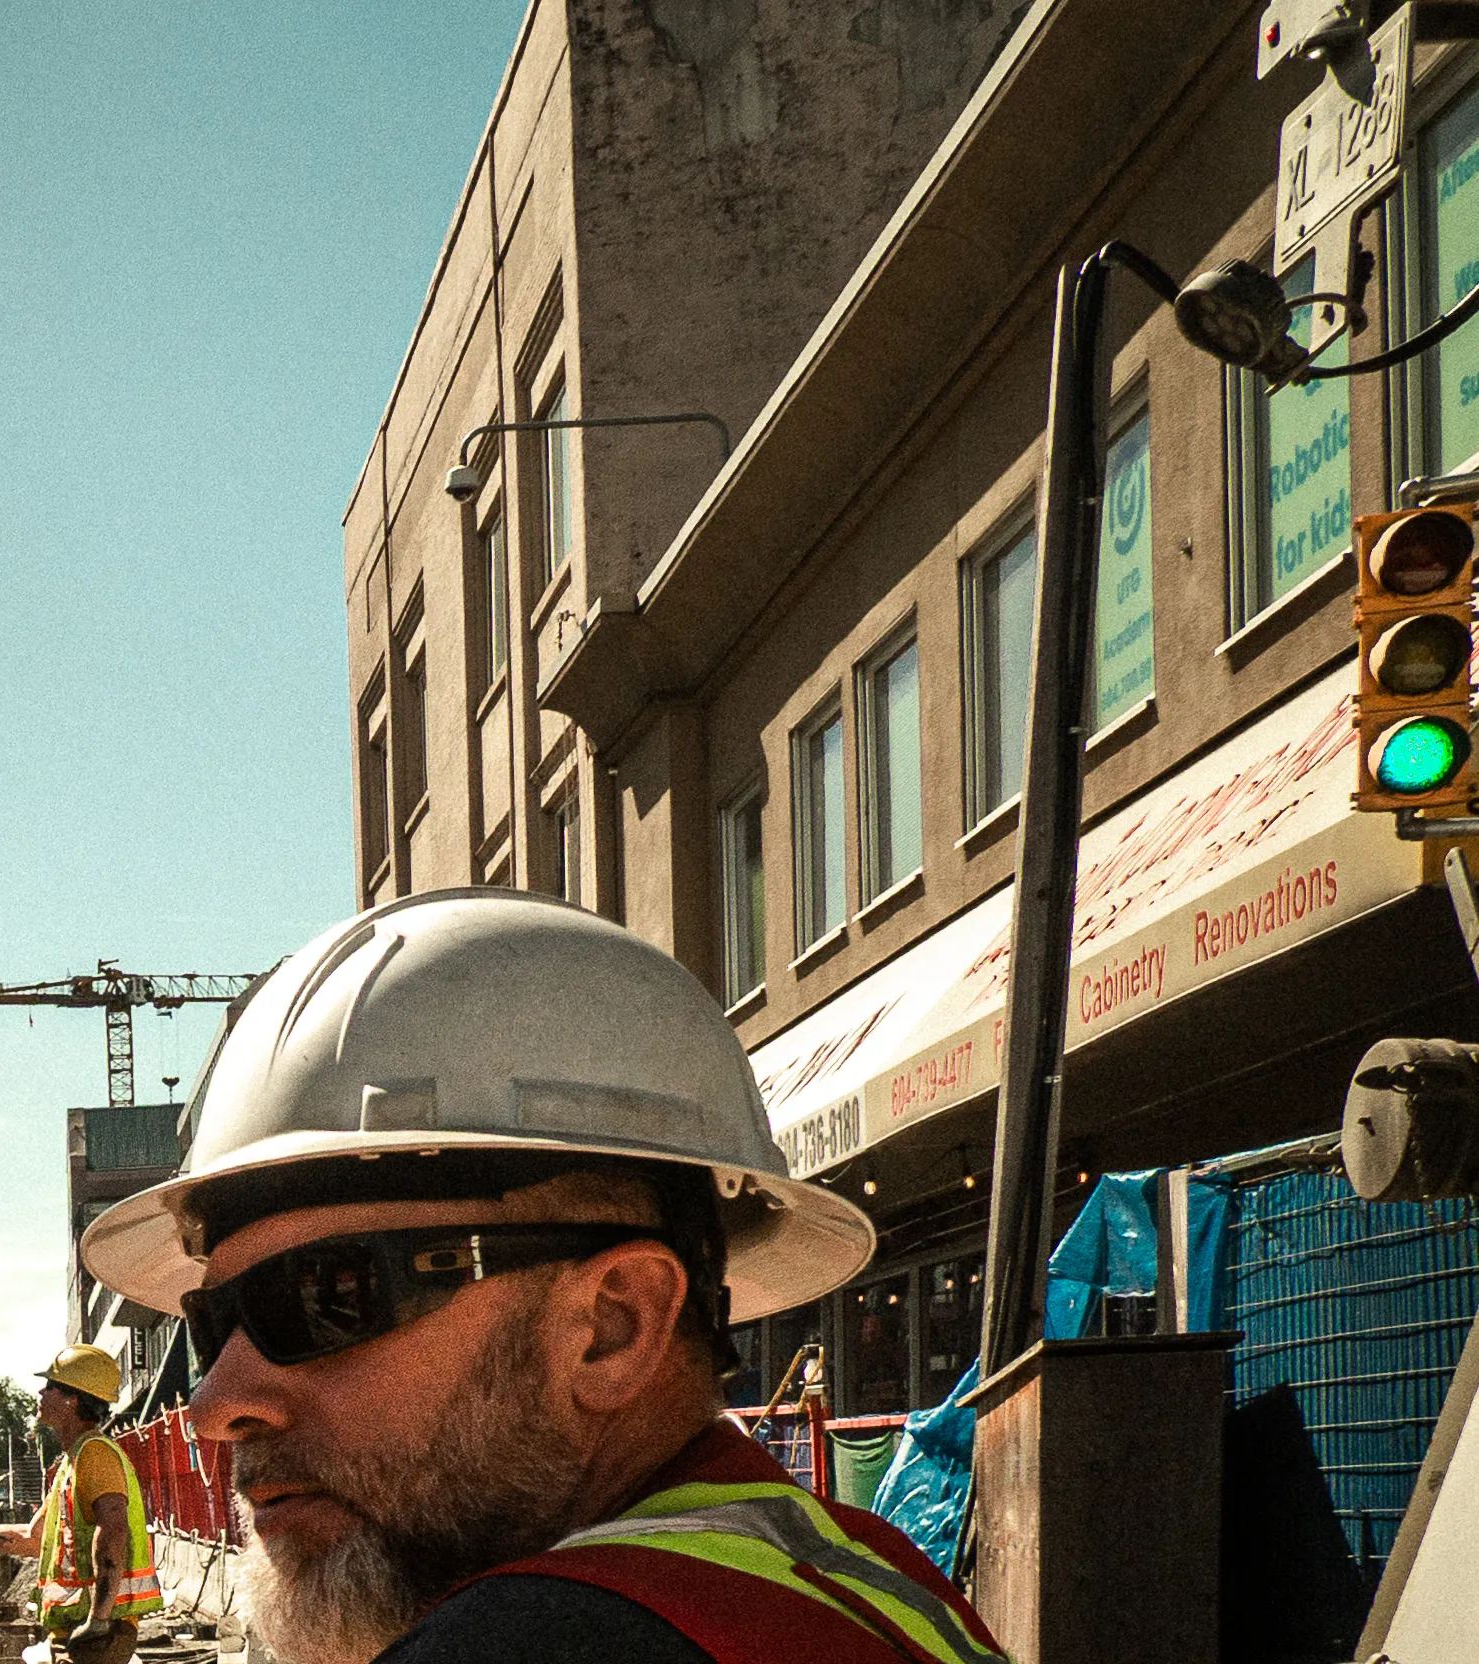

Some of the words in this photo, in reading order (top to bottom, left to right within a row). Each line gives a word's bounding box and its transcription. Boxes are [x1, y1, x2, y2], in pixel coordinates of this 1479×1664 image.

[1284, 144, 1315, 222] XL
[1276, 527, 1307, 580] for
[1310, 487, 1350, 556] kid
[1080, 944, 1166, 1024] Cabinetry
[1194, 860, 1337, 966] Renovations
[892, 1041, 973, 1117] 604-739-4477
